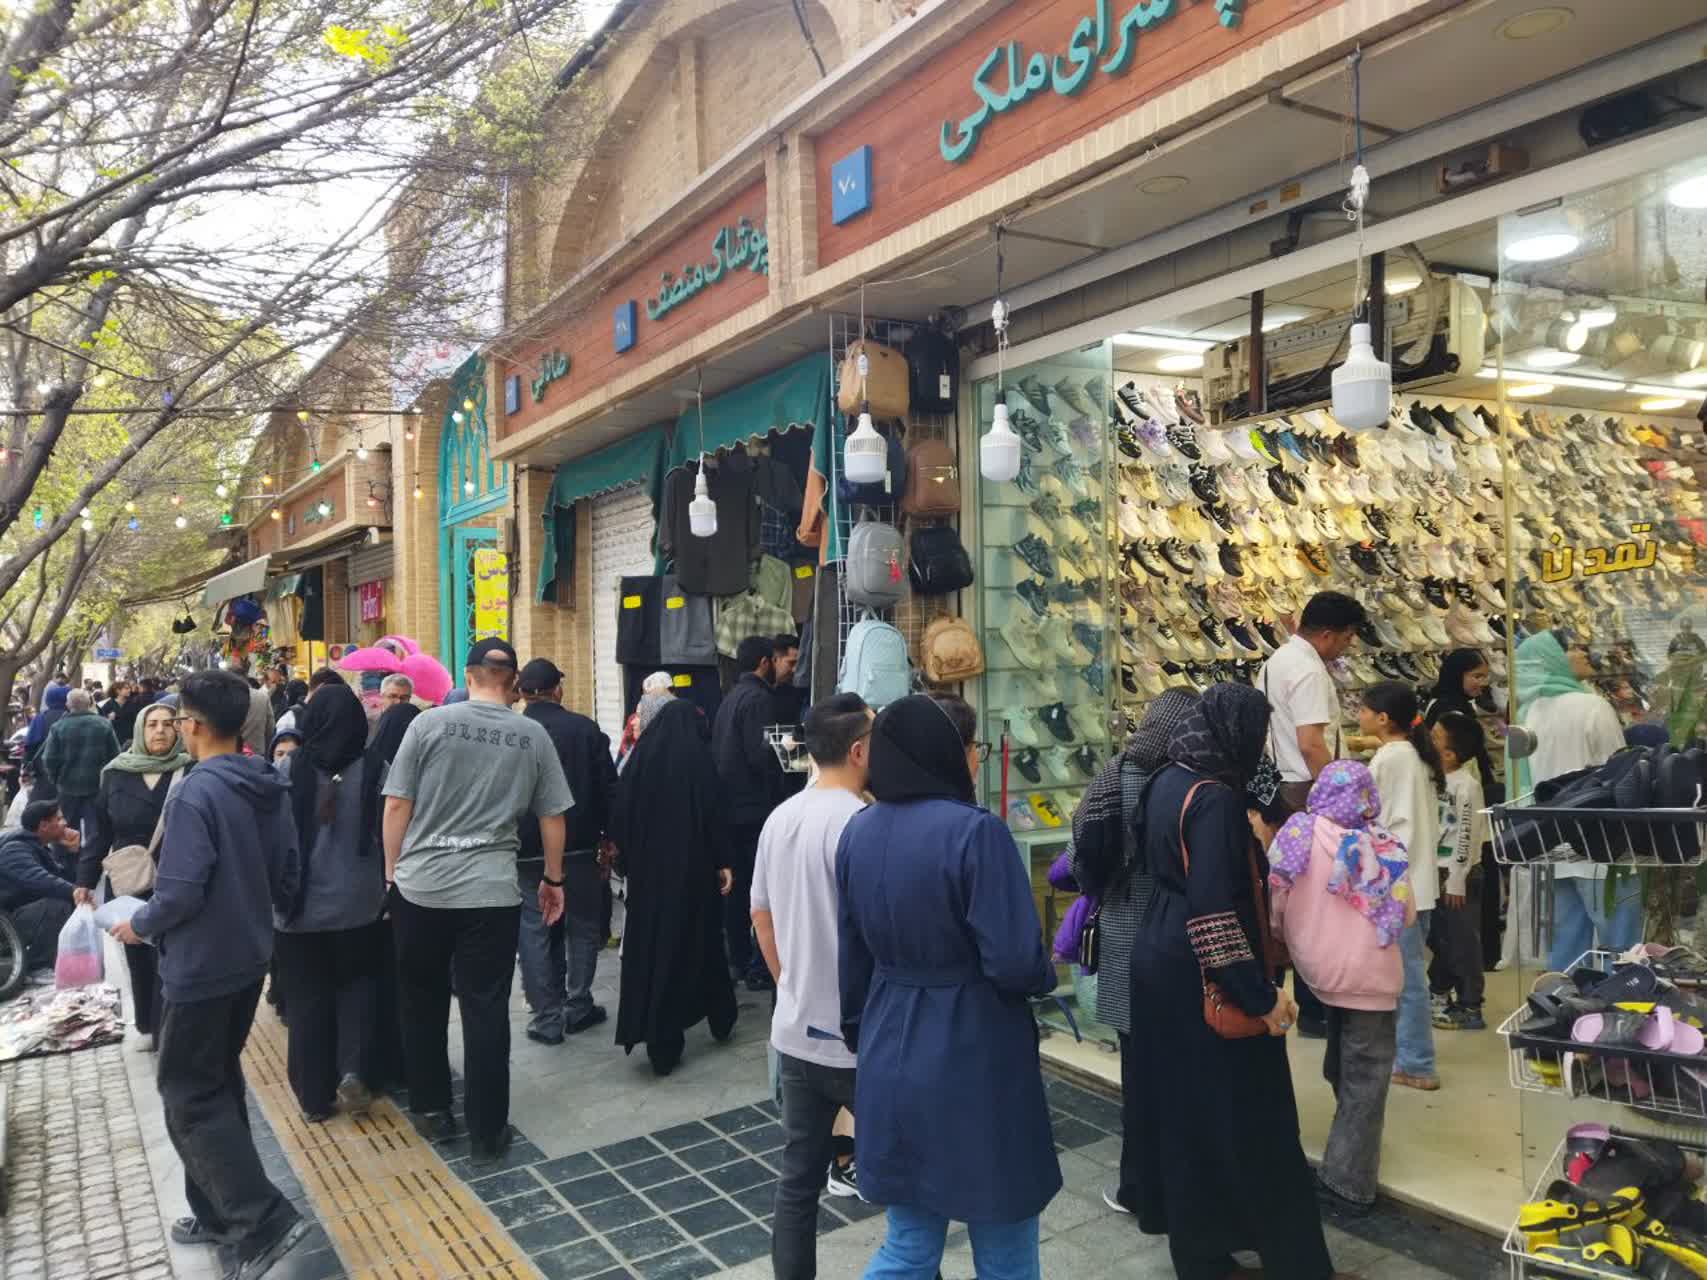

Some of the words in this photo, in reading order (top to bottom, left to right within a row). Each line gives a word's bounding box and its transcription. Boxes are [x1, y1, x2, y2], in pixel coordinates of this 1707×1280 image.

[940, 41, 1047, 162] ملکی
[838, 176, 856, 197] ۷۰
[645, 263, 705, 321] منصف
[1541, 522, 1659, 583] تمدن
